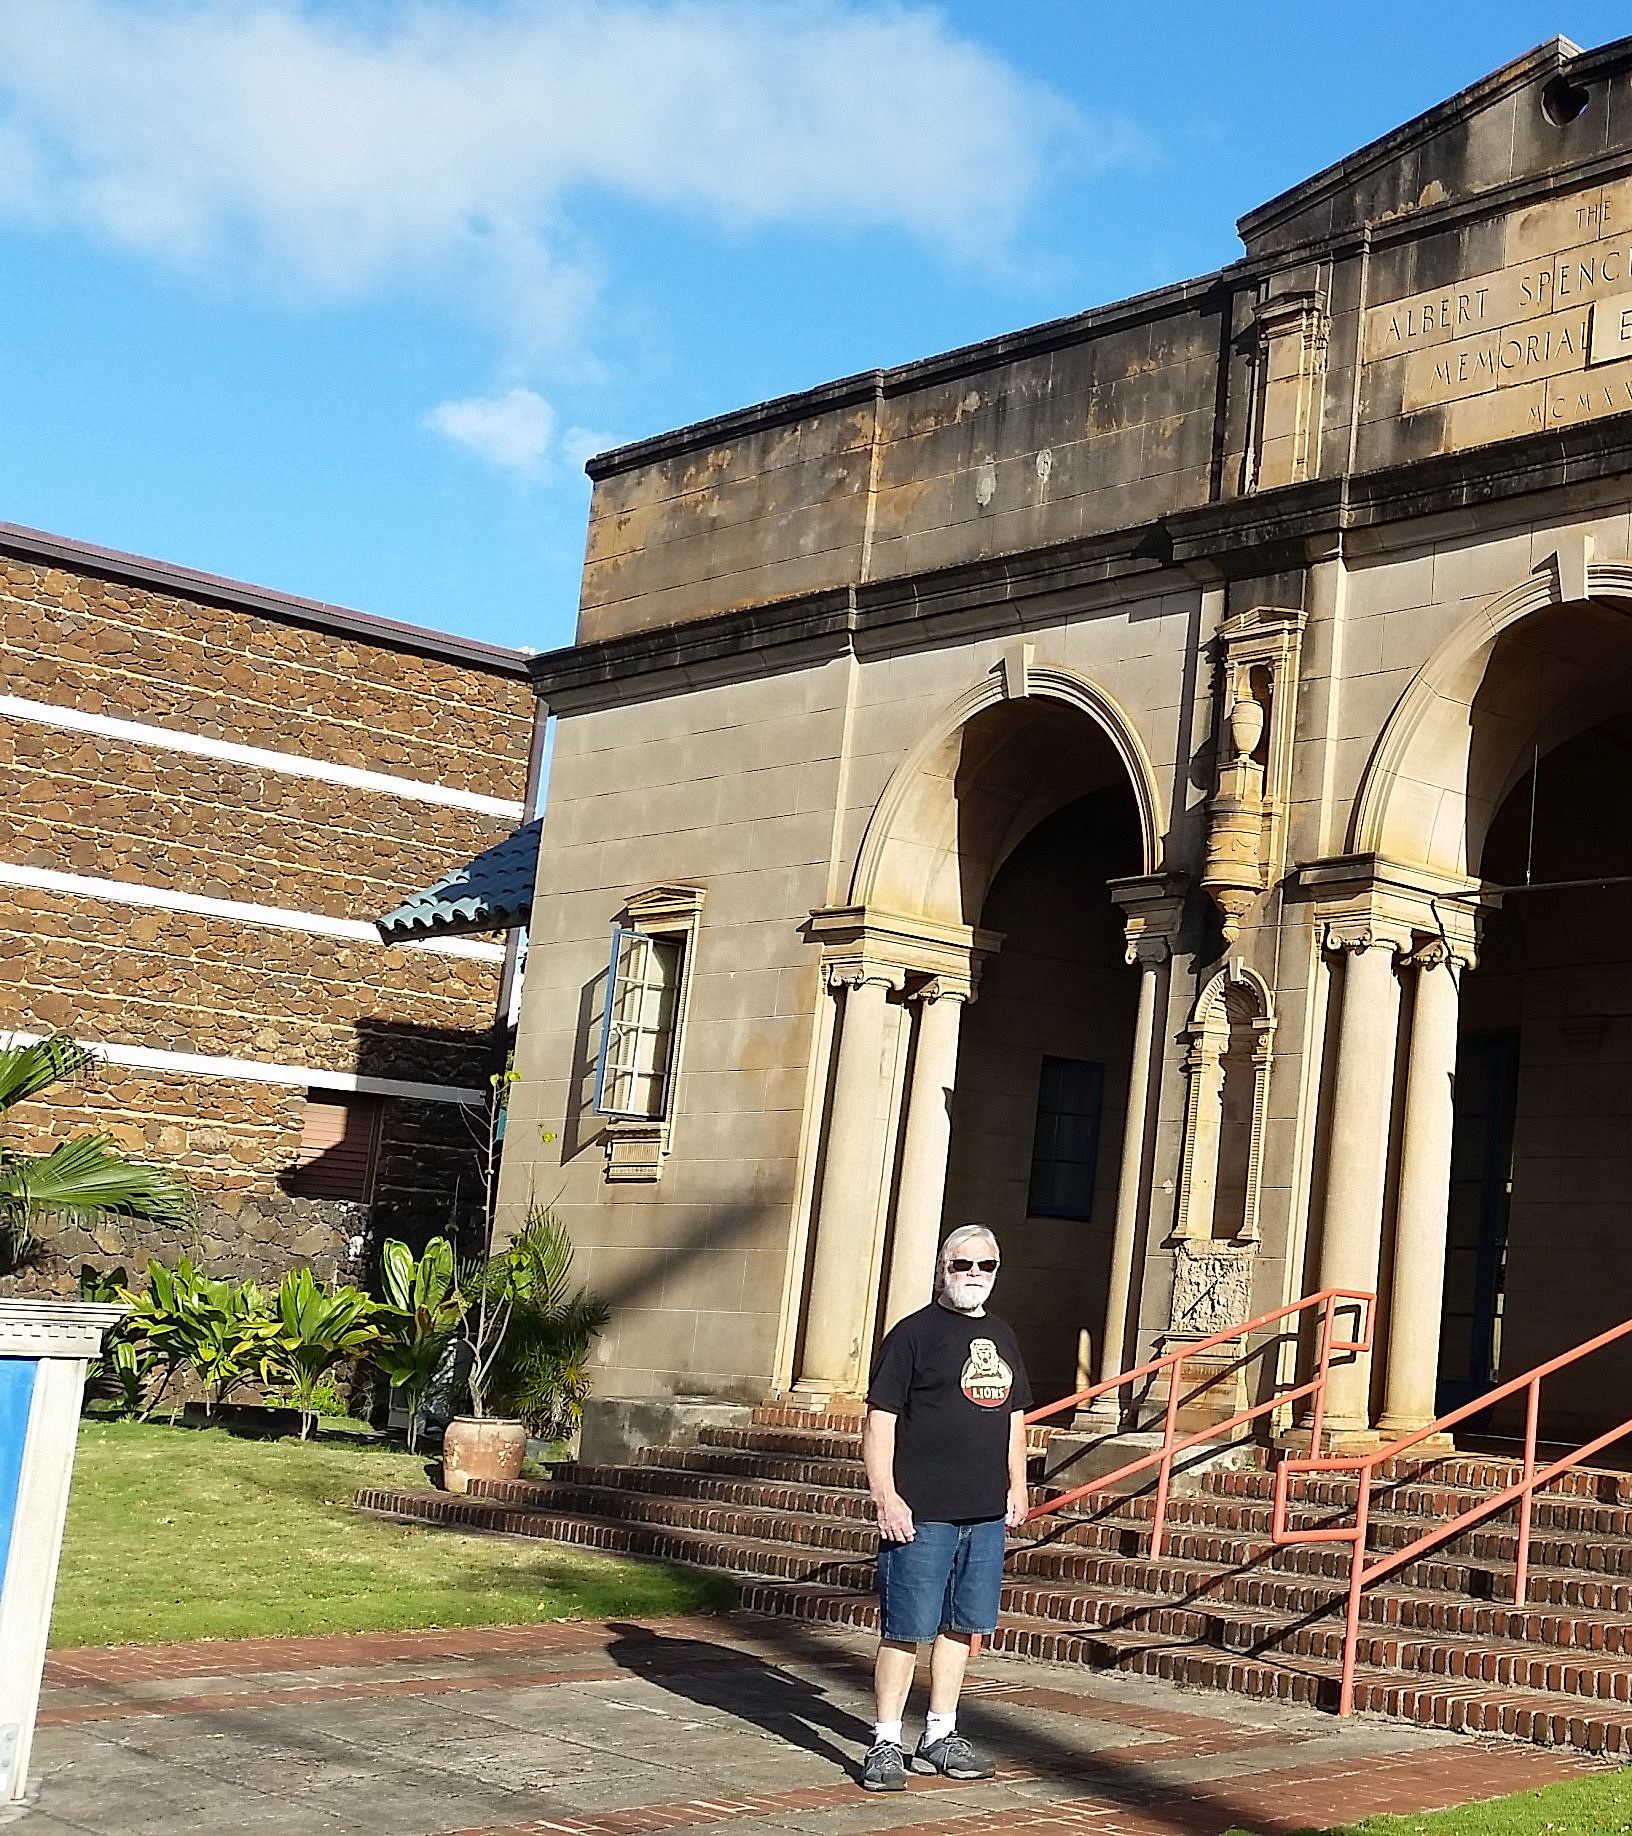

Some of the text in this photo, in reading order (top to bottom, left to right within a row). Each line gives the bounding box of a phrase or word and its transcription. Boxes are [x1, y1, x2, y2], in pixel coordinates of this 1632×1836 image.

[1576, 200, 1612, 229] THE
[1385, 288, 1489, 344] ALBERT
[1428, 321, 1588, 392] MEMORIAL
[972, 1386, 1005, 1399] LIONS
